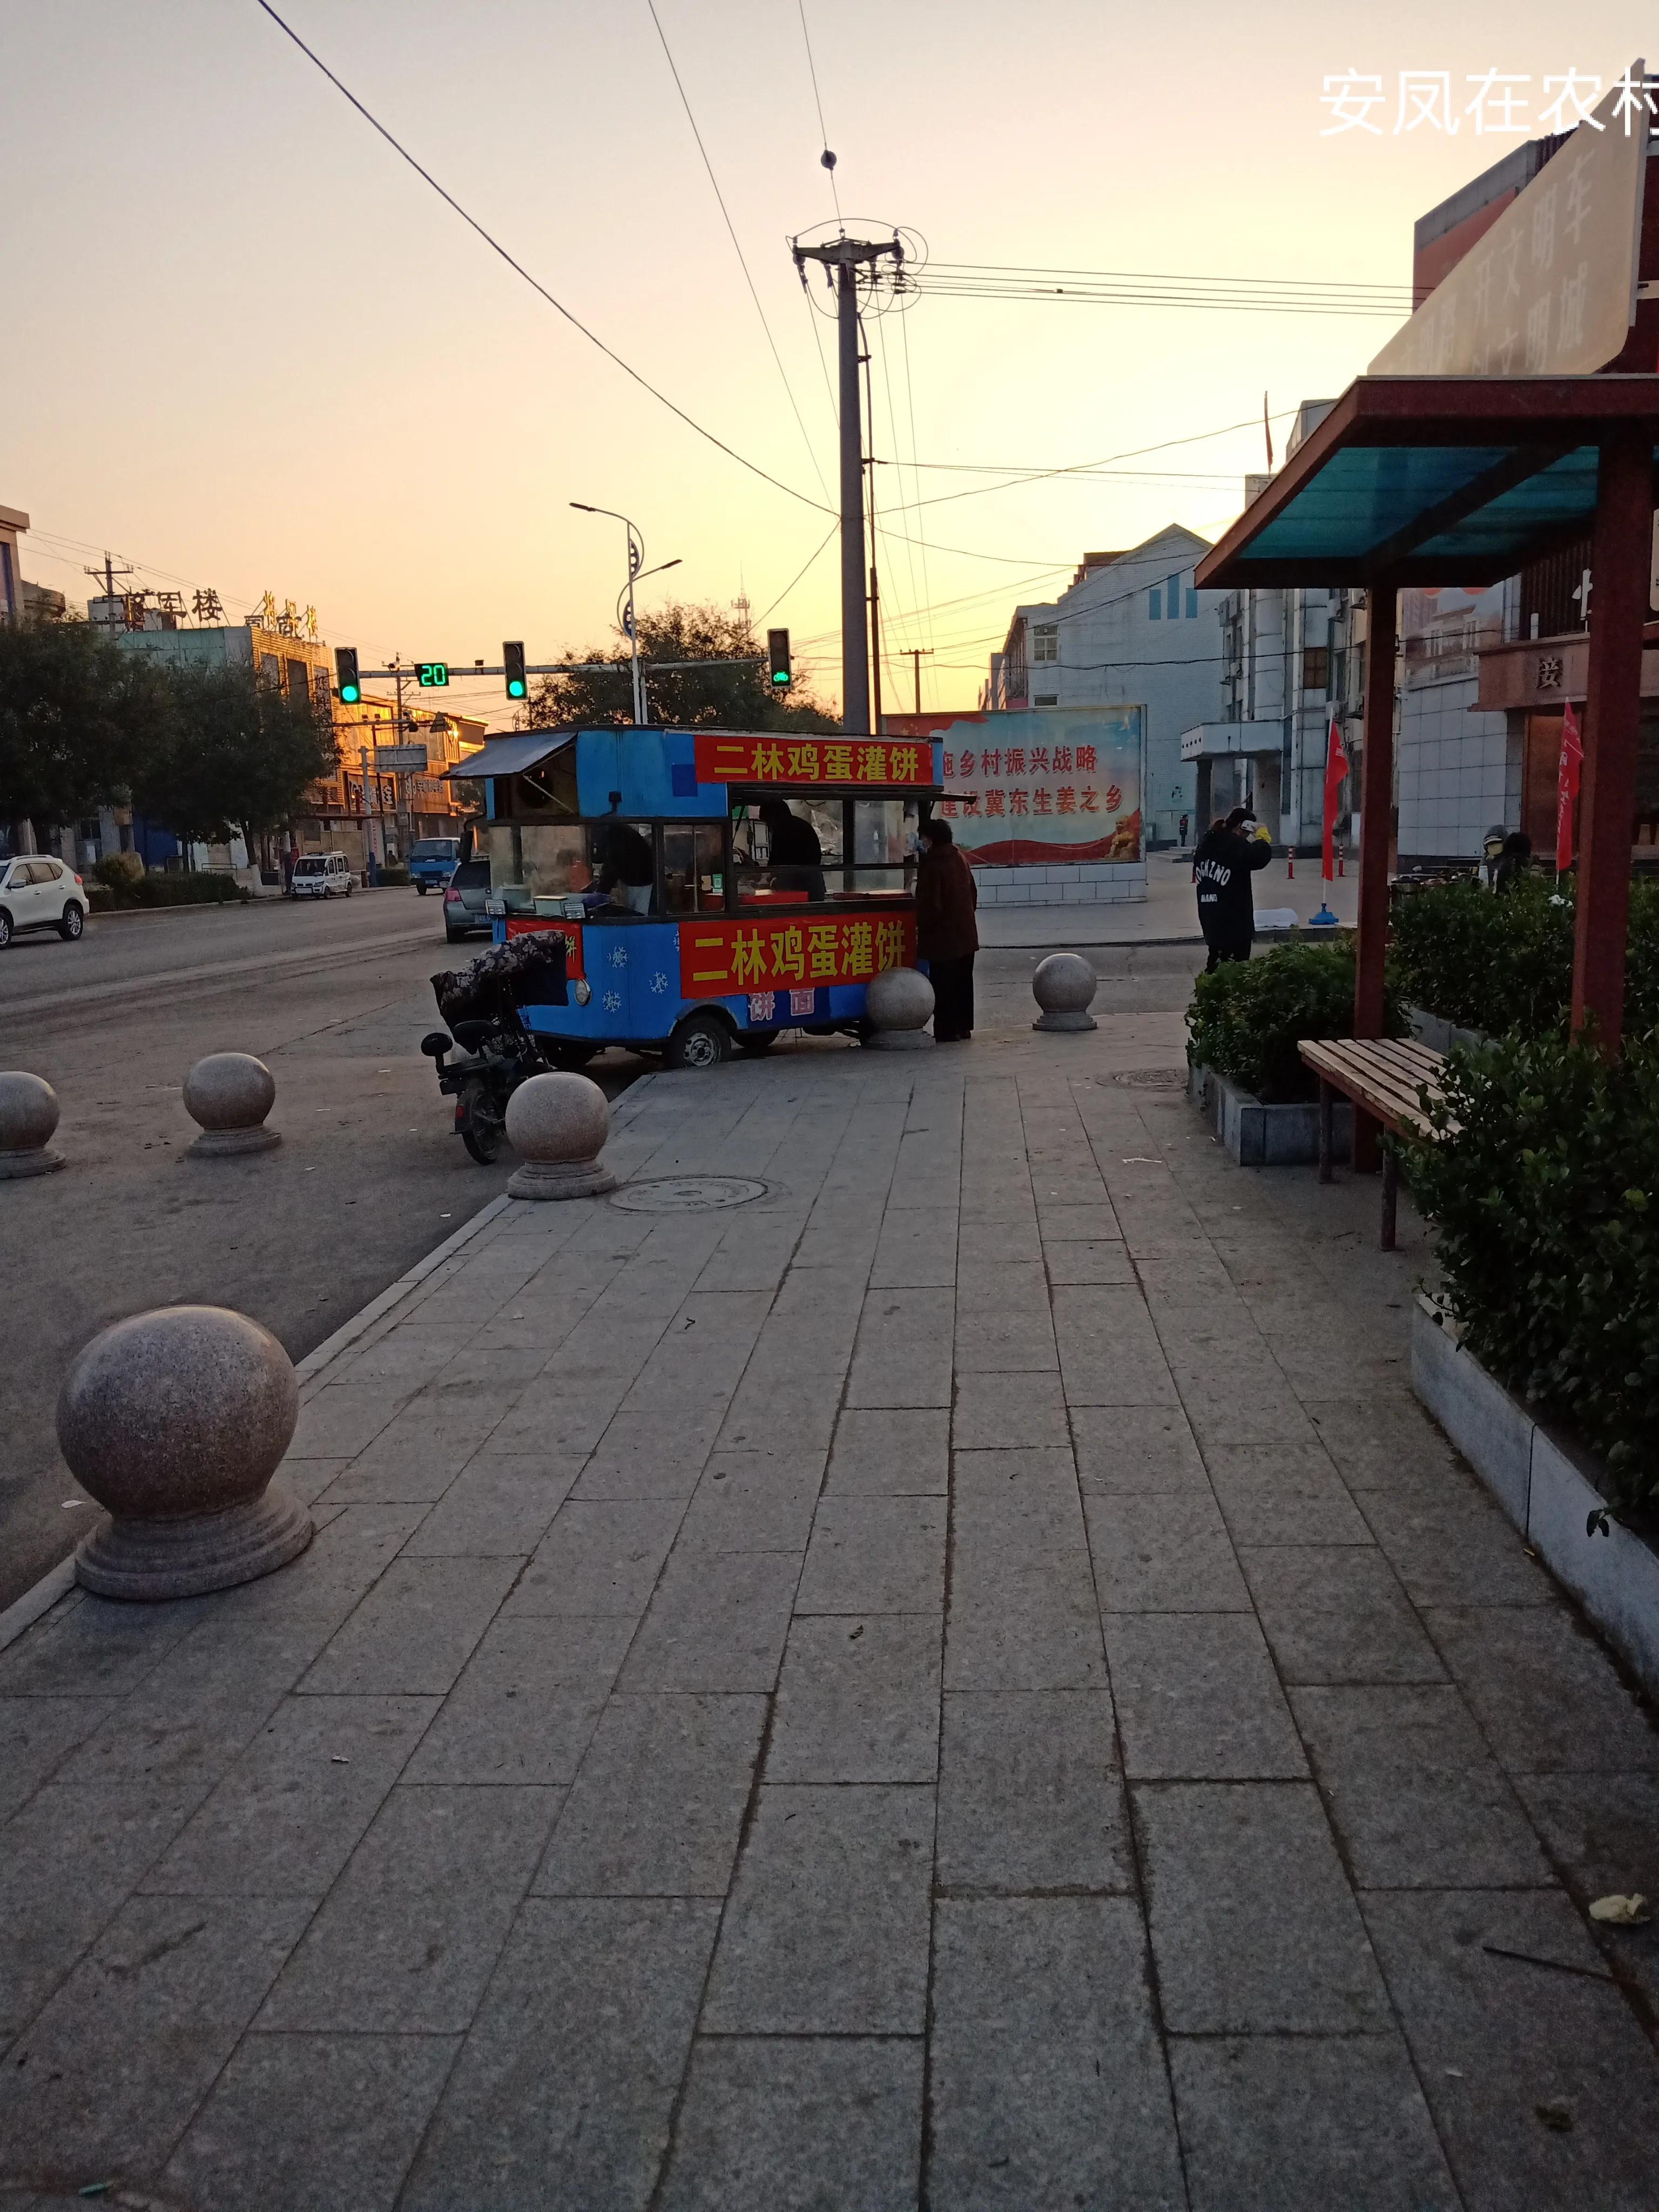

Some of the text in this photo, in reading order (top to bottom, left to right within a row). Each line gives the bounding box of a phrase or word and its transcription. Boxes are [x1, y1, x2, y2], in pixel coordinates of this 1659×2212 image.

[421, 665, 446, 685] 20
[714, 743, 919, 781] 二林鸡蛋灌饼
[693, 920, 906, 985] 二林鸡蛋灌饼
